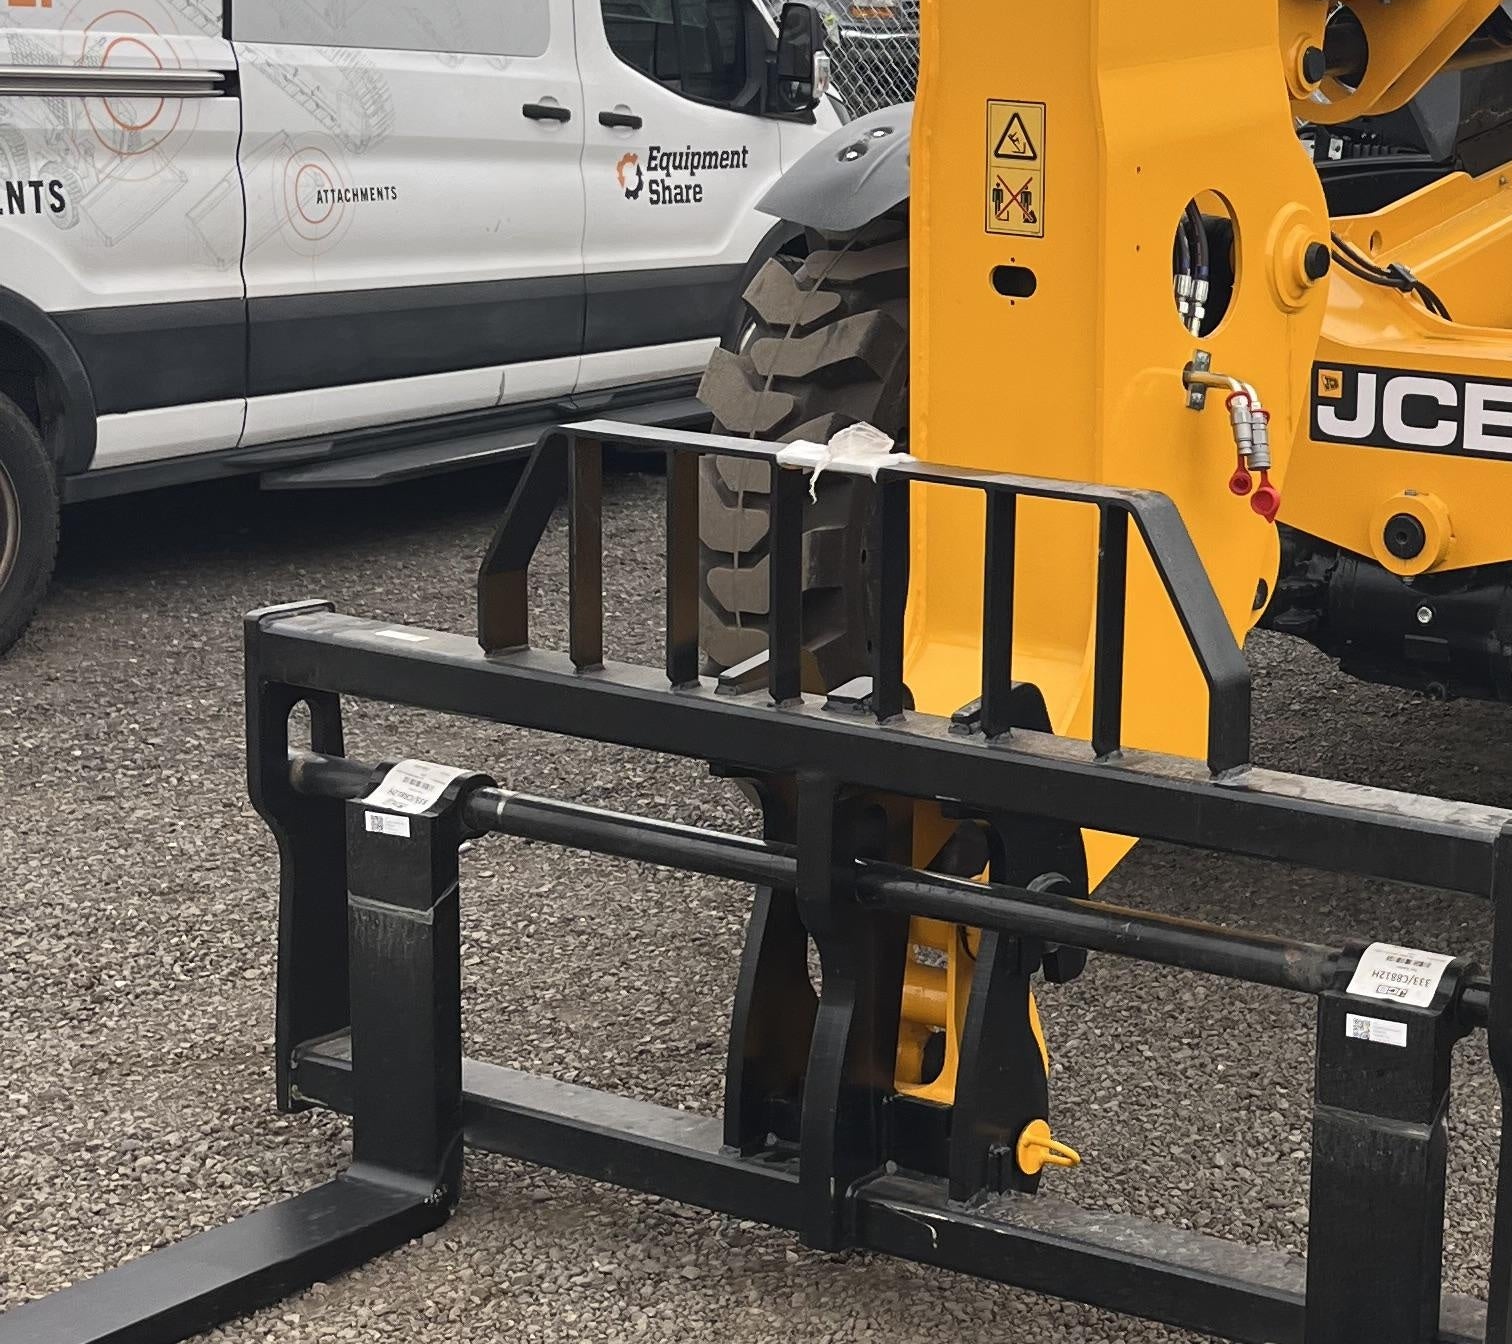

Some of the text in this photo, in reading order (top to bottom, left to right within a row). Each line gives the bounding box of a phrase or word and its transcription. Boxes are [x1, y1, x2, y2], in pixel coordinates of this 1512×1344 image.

[647, 145, 748, 177] Equipment
[0, 180, 65, 214] NTS
[316, 186, 398, 204] ATTACHMENTS
[648, 179, 703, 205] Share
